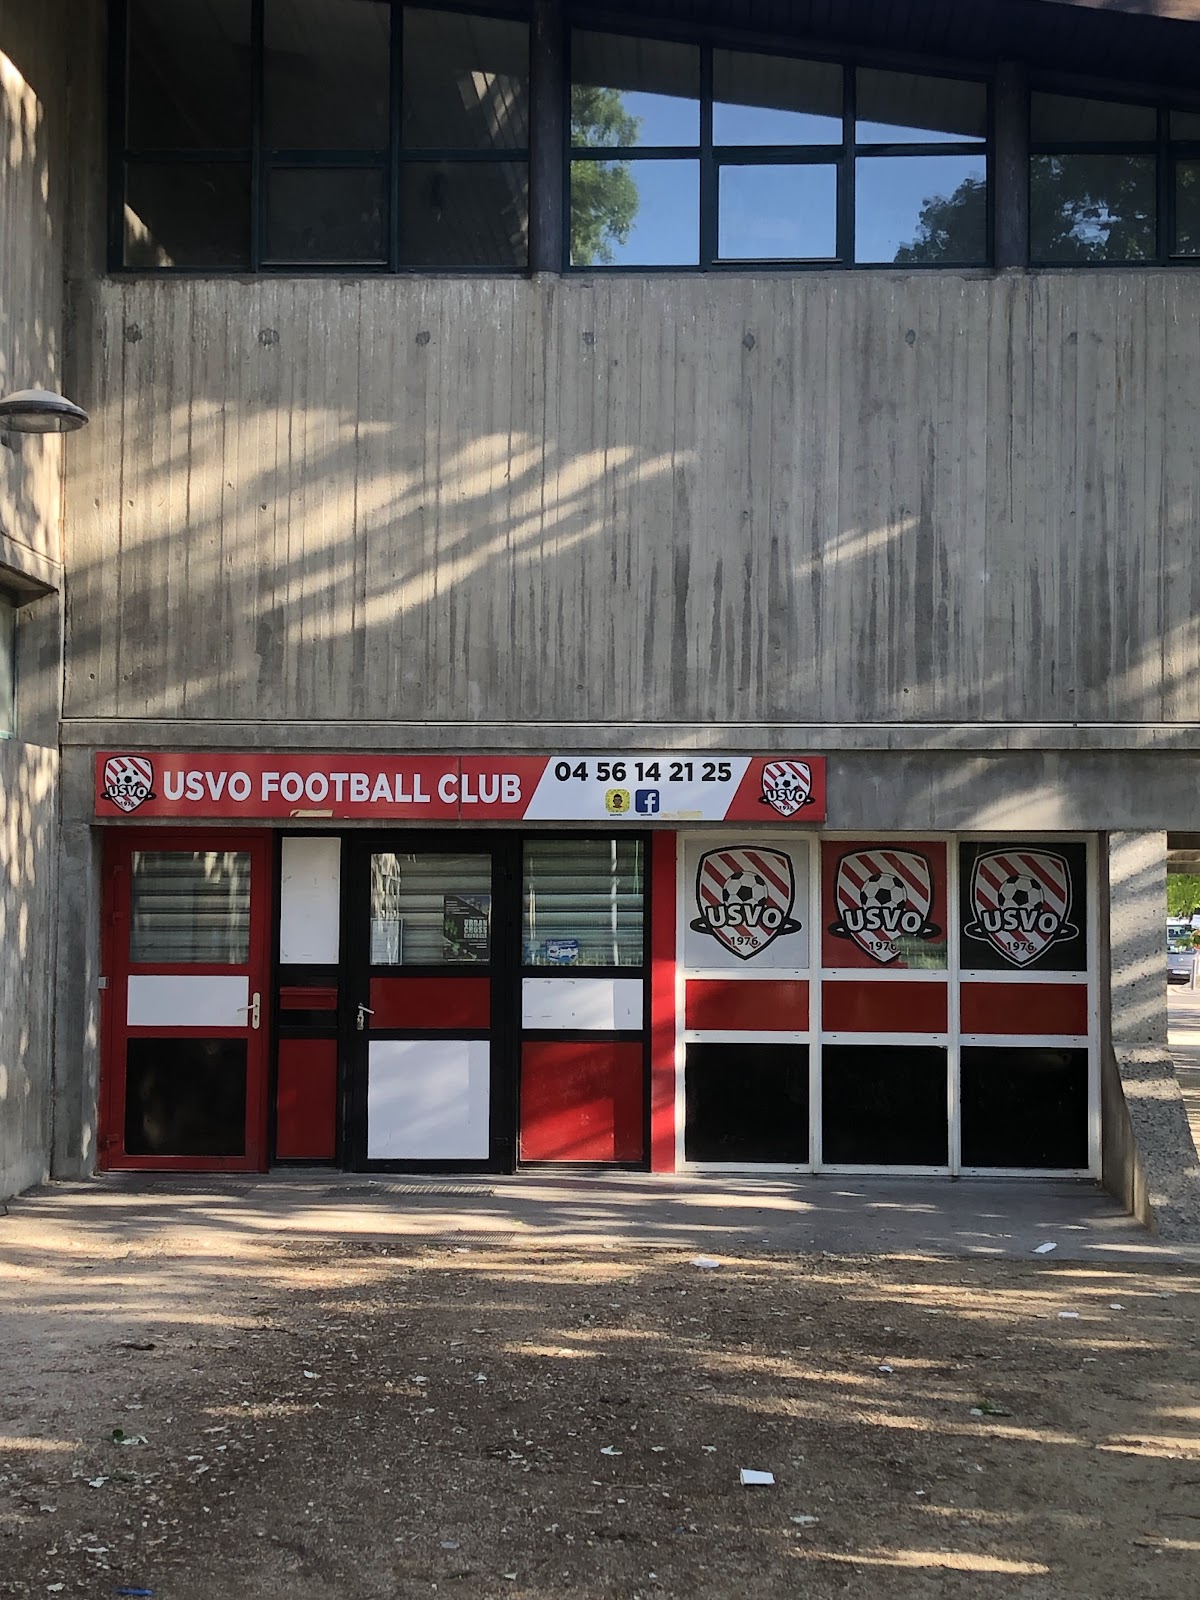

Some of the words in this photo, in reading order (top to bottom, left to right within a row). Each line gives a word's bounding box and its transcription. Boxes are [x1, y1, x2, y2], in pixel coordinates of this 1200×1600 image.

[555, 761, 588, 782] 04
[596, 761, 627, 782] 56
[635, 761, 661, 782] 14
[669, 761, 694, 782] 21
[701, 761, 732, 782] 25
[109, 785, 148, 798] USVO
[163, 771, 252, 801] USVO
[261, 772, 431, 803] FOOTBALL
[437, 773, 522, 804] CLUB
[767, 789, 806, 802] USVO
[707, 904, 782, 929] USVO
[845, 908, 922, 933] USVO
[983, 910, 1059, 934] USVO
[731, 936, 759, 946] 1976
[869, 941, 897, 951] 1976
[1007, 941, 1035, 951] 1976
